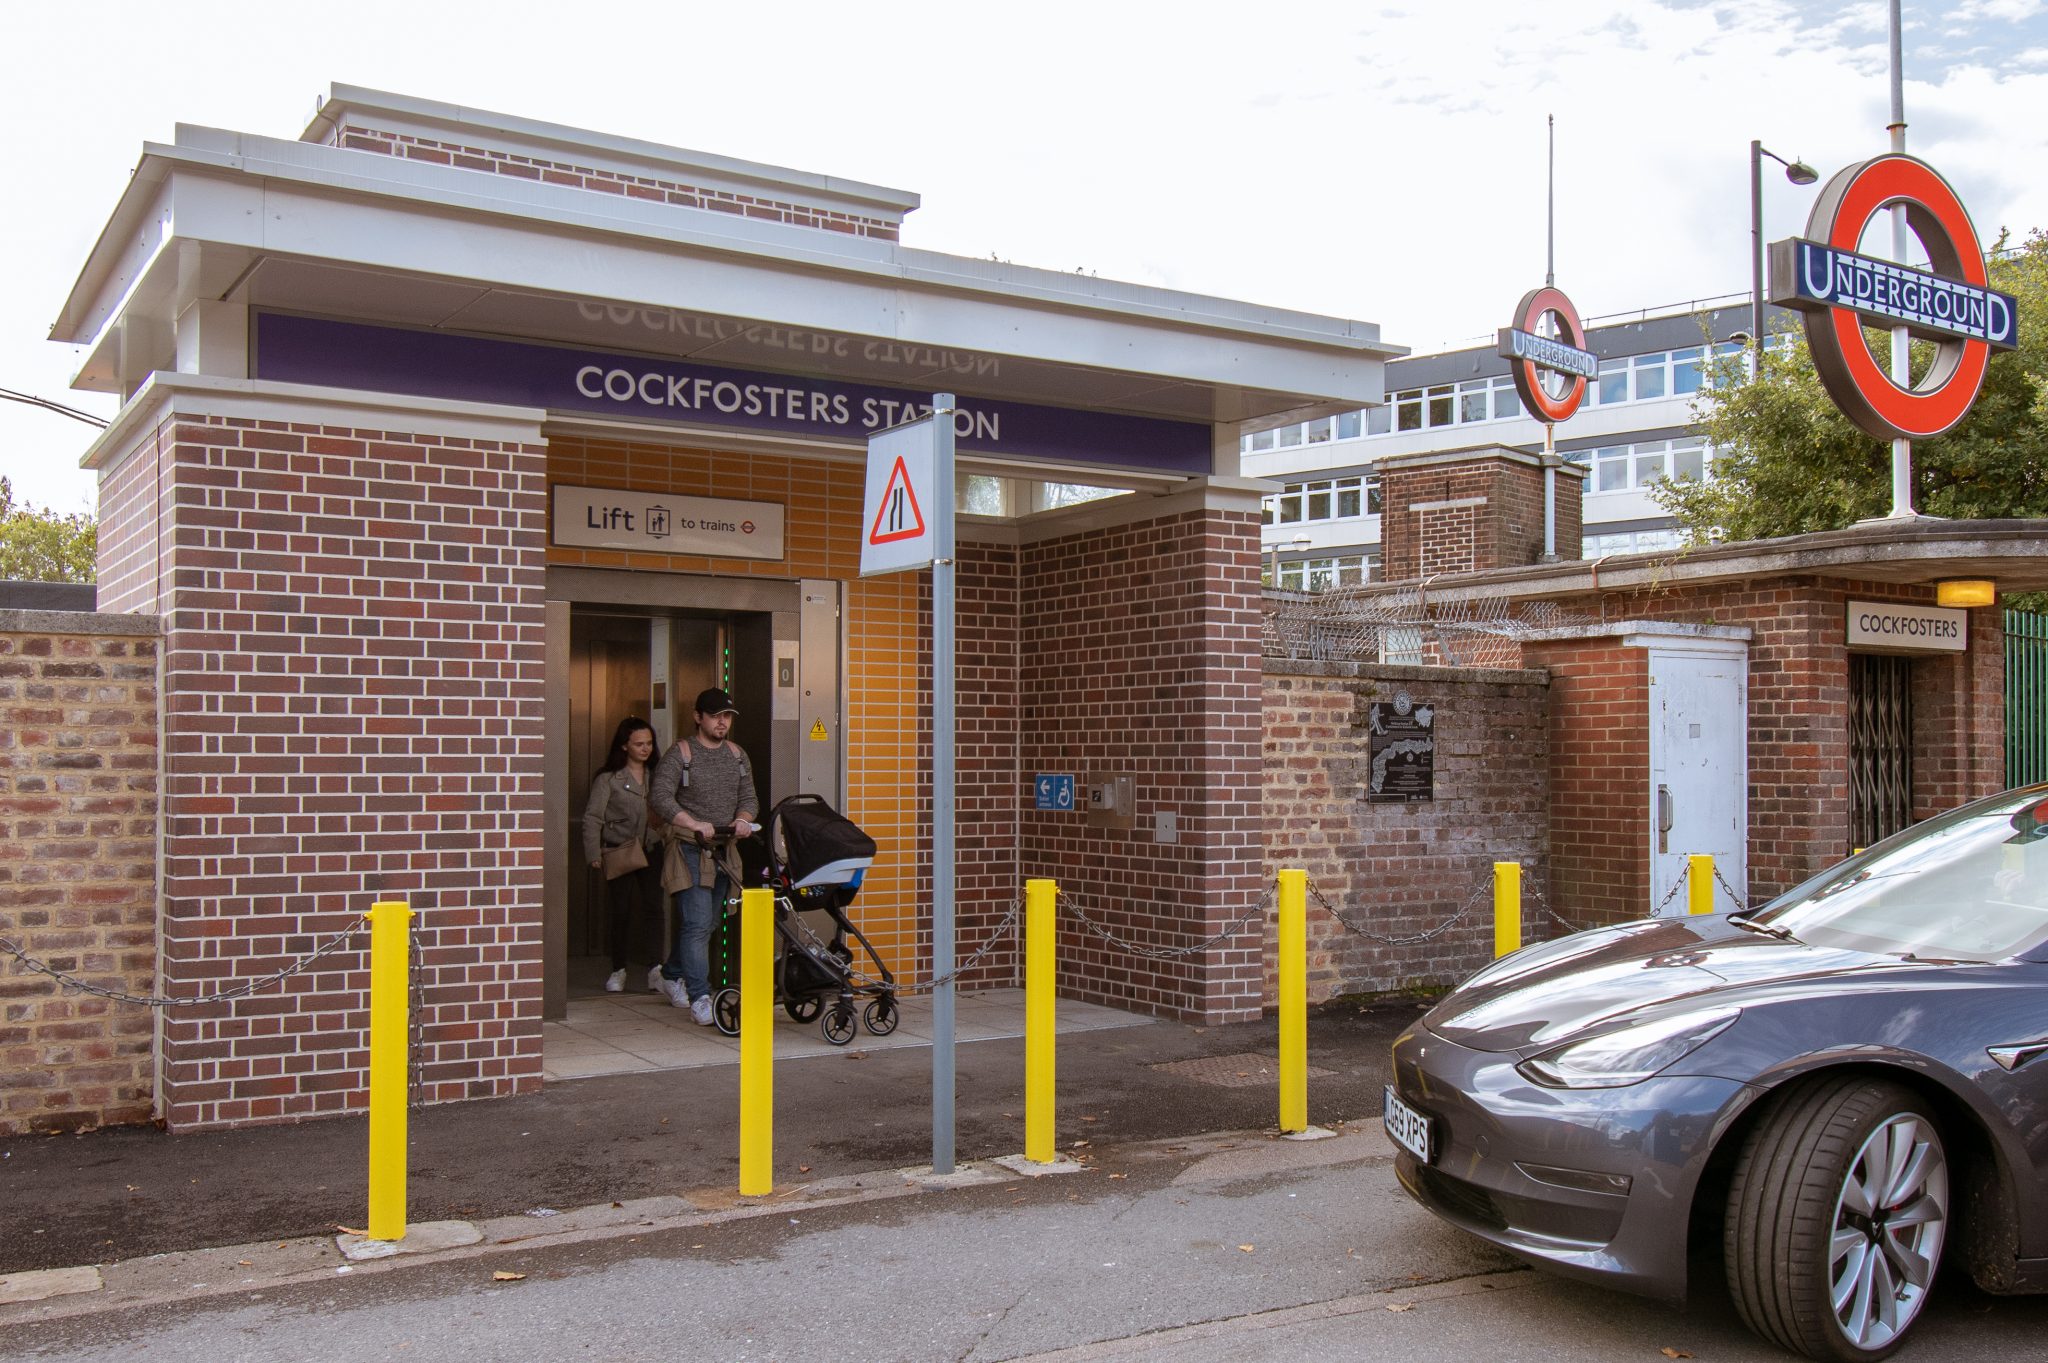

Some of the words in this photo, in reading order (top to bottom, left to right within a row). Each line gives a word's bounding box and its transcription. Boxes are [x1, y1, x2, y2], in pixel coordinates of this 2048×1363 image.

[1804, 244, 2010, 342] UNDERGROUND
[1513, 330, 1596, 376] UNDERGROUND
[575, 365, 849, 425] COCKFOSTERS
[862, 398, 999, 441] STAON
[587, 505, 635, 532] Lift
[681, 517, 695, 530] to
[700, 519, 736, 533] trains
[1859, 614, 1958, 638] COCKFOSTERS
[782, 668, 790, 681] 0
[1406, 1111, 1426, 1153] XPS
